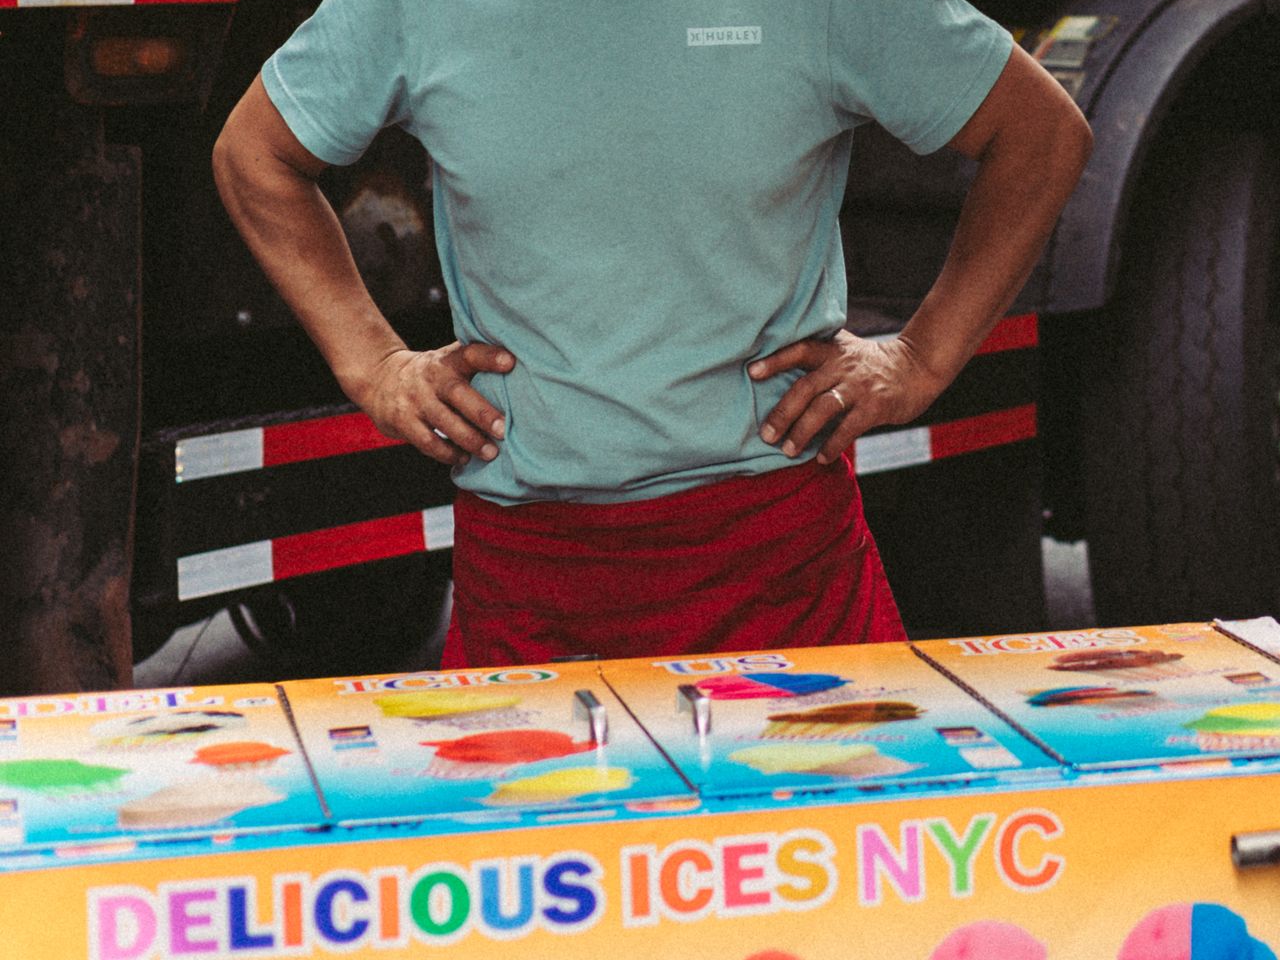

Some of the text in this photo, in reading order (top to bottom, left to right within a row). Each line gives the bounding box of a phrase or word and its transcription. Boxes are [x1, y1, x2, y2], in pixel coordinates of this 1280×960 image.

[705, 30, 759, 41] HURLEY
[950, 629, 1147, 656] ICES
[651, 654, 795, 676] US
[0, 690, 224, 723] DEL
[94, 810, 1062, 960] DELICIOUS ICES NYC
